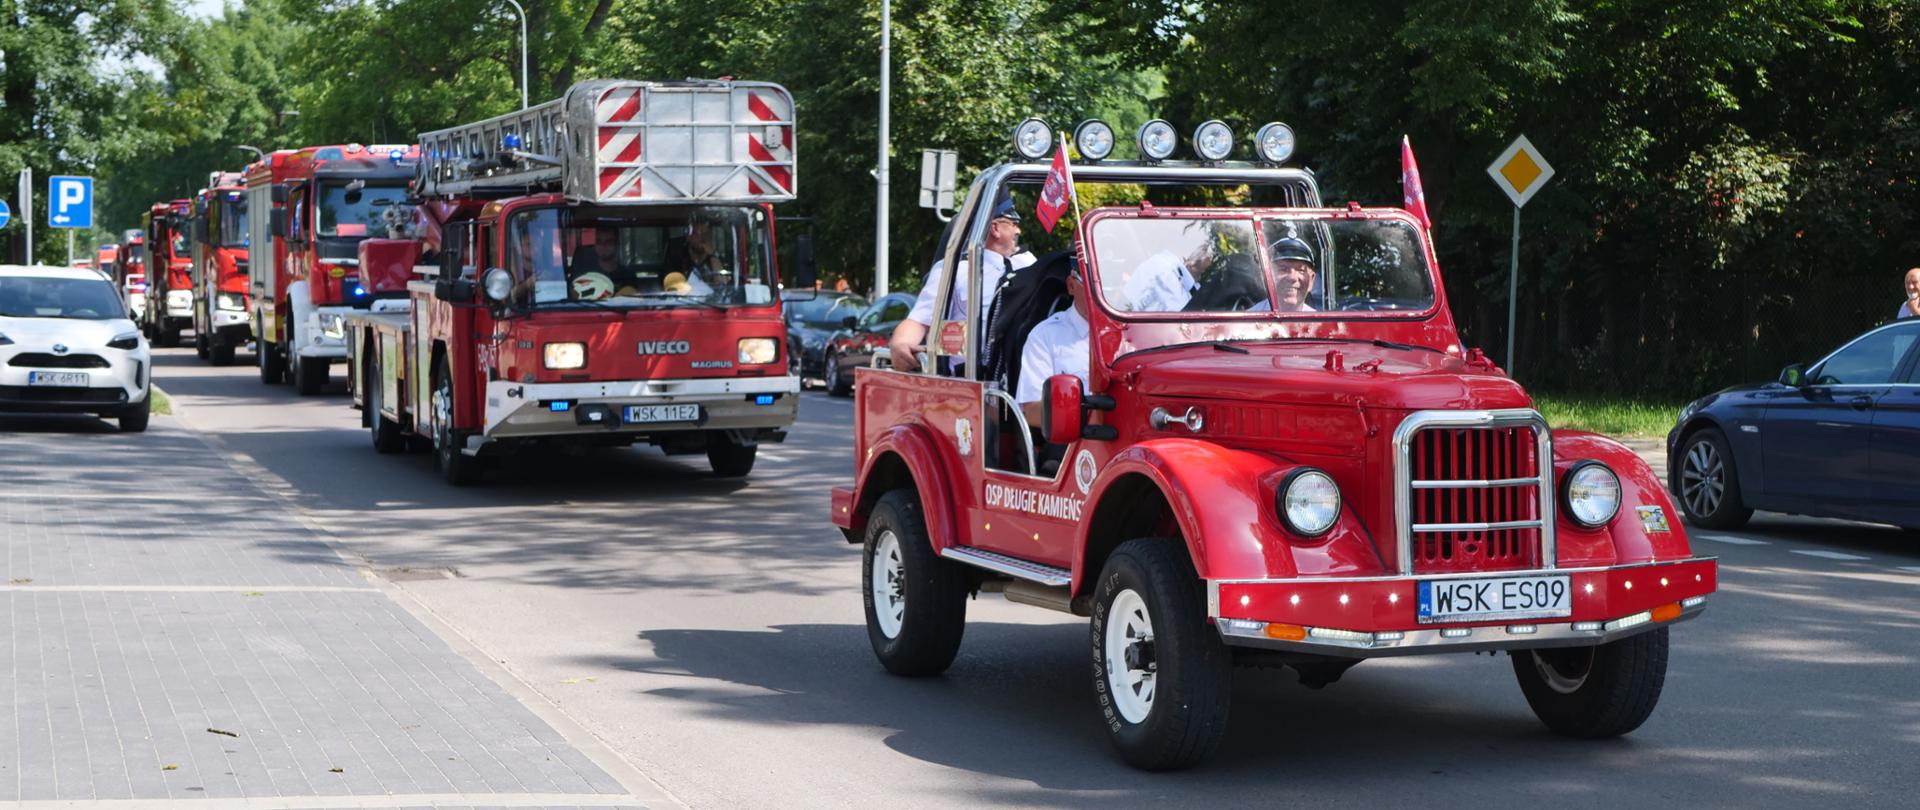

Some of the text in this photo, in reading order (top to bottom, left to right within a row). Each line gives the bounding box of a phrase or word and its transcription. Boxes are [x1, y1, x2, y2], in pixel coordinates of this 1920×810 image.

[59, 180, 84, 212] P
[638, 340, 690, 355] IVECO
[691, 360, 733, 369] MAGIRUS
[633, 405, 696, 421] WSK 11E2
[985, 483, 1085, 522] OSP DŁUGIE KAMIEŃS
[1436, 579, 1565, 613] WSK ES09
[1420, 604, 1431, 613] PL
